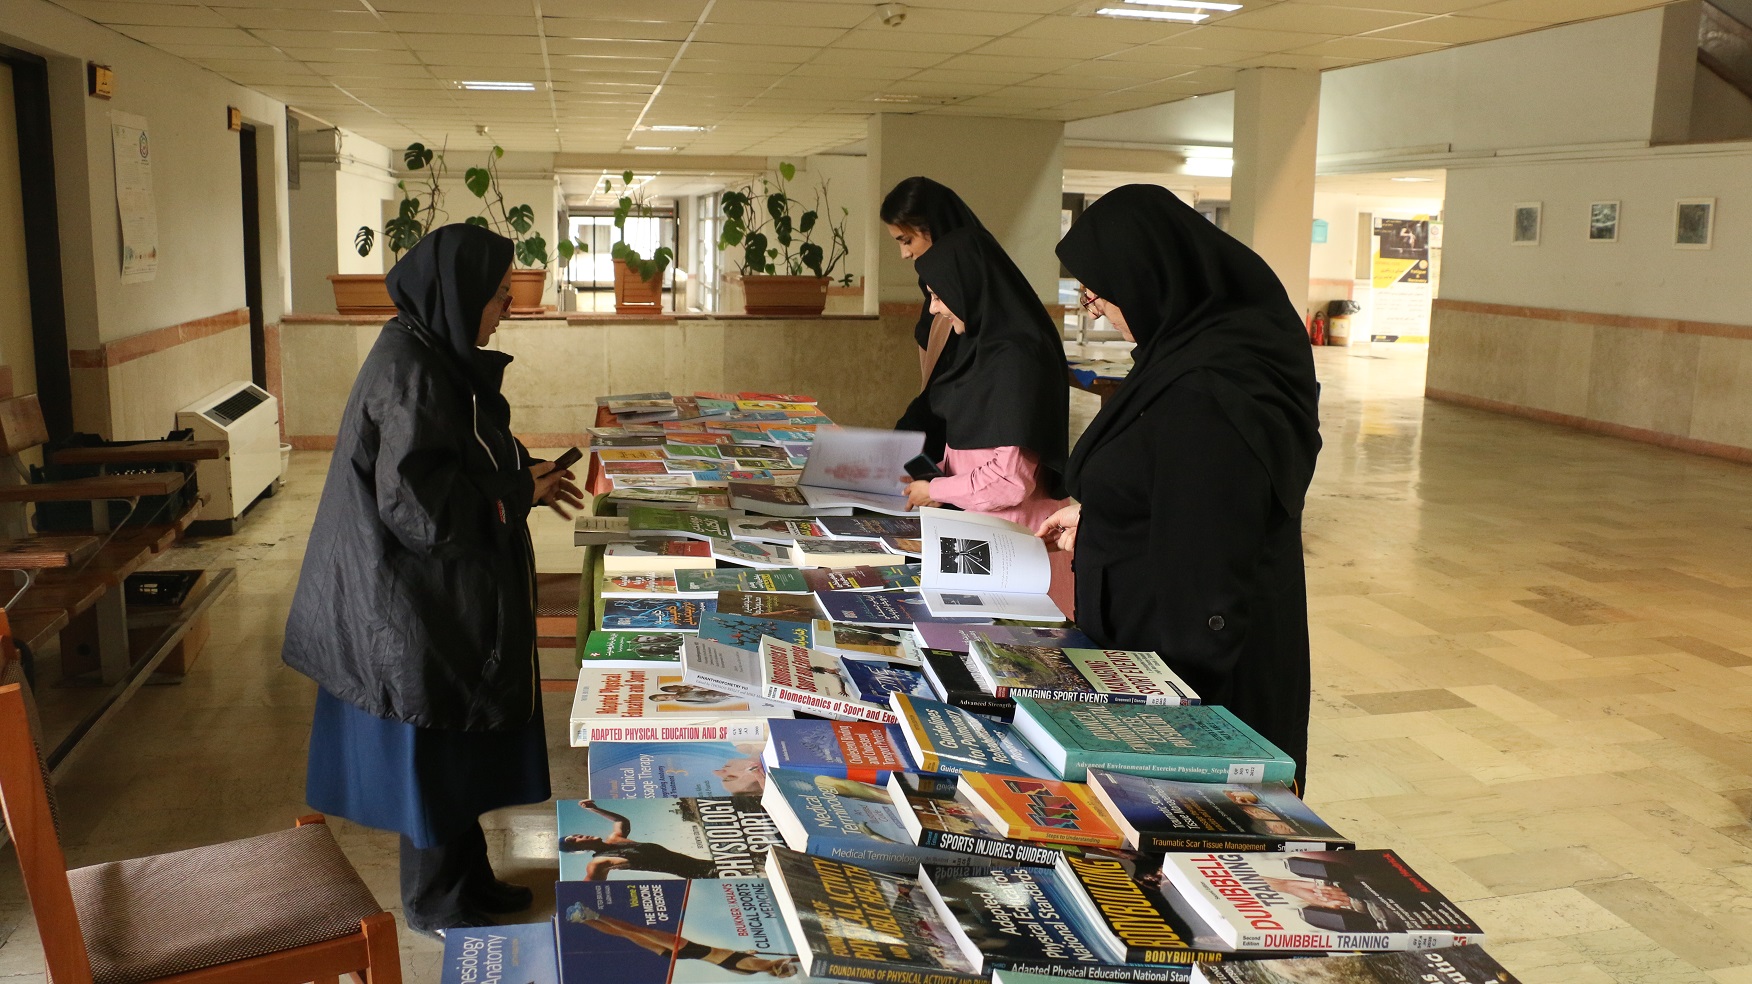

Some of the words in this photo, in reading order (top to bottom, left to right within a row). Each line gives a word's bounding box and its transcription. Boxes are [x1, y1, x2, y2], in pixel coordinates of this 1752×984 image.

[767, 643, 787, 653] of
[791, 646, 811, 667] Exercise
[769, 651, 792, 687] Biomechanics
[793, 665, 814, 677] and
[1103, 650, 1144, 674] EVENTS
[599, 673, 624, 693] Physical
[625, 670, 648, 683] Sport
[794, 674, 818, 693] Sport
[1084, 660, 1135, 693] MANAGING
[1123, 674, 1164, 695] SPORT
[624, 684, 644, 693] and
[1009, 687, 1051, 700] MANAGING
[1052, 690, 1078, 702] SPORT
[1079, 692, 1109, 704] EVENTS
[595, 694, 622, 714] Adapted
[621, 693, 644, 718] Education
[779, 689, 831, 711] Biomechanics
[833, 702, 842, 712] of
[843, 703, 865, 717] Sport
[866, 709, 880, 720] and
[960, 699, 987, 707] Advanced
[987, 701, 1012, 709] Strength
[591, 728, 623, 741] ADAPTED
[624, 728, 659, 741] PHYSICAL
[661, 727, 700, 740] EDUCATION
[702, 727, 717, 740] AND
[838, 725, 853, 741] Binding
[870, 729, 887, 746] Proteins
[925, 708, 959, 749] Guidelines
[944, 708, 980, 747] Pulmonary
[1070, 710, 1120, 742] ADVANCED
[1085, 705, 1156, 752] ENVIRONMENTAL
[1117, 715, 1168, 743] EXERCISE
[1136, 712, 1197, 749] PHYSIOLOGY
[854, 734, 875, 756] Cholesterol
[966, 715, 1011, 765] Rehabilitation
[842, 741, 862, 764] Cholesterol
[864, 756, 879, 765] and
[877, 745, 896, 766] Transport
[966, 746, 987, 760] for
[638, 753, 655, 780] Therapy
[658, 766, 667, 782] Anatomy
[1076, 760, 1105, 769] Advanced
[1107, 762, 1151, 772] Environmental
[619, 767, 636, 792] Clinical
[642, 781, 658, 799] ssage
[668, 775, 678, 795] Treatment
[817, 784, 861, 835] Terminology
[1147, 793, 1164, 805] Scar
[1148, 784, 1185, 815] Management
[798, 794, 837, 829] Medical
[1156, 805, 1186, 828] Traumatic
[1179, 814, 1201, 829] Tissue
[697, 799, 758, 879] PHYSIOLOGY
[737, 810, 786, 853] SPORT
[1064, 834, 1101, 844] Understanding
[939, 832, 974, 853] SPORTS
[974, 836, 1015, 859] INJURIES
[1015, 845, 1059, 866] GUIDEBOO
[1152, 837, 1185, 848] Traumatic
[1185, 839, 1201, 849] Scar
[1203, 840, 1224, 849] Tissue
[1224, 841, 1266, 852] Management
[831, 848, 866, 860] Medical
[867, 851, 921, 865] Terminology
[810, 857, 859, 907] ACTIVITY
[841, 864, 886, 906] HEALTH
[1217, 854, 1290, 907] TRAINING
[629, 889, 639, 908] Volume
[639, 884, 654, 913] MEDICINE
[651, 884, 667, 911] EXERCISE
[722, 883, 738, 904] KHAN'S
[735, 883, 757, 911] SPORTS
[751, 883, 777, 919] MEDICINE
[990, 870, 1035, 920] Education
[1010, 869, 1060, 920] Standards
[1068, 856, 1189, 949] BODYBUILDING
[1189, 854, 1285, 931] DUMBBELL
[811, 899, 831, 910] OF
[971, 891, 1022, 936] Adapted
[644, 912, 657, 926] THE
[657, 912, 669, 922] OF
[729, 908, 749, 937] BRUKNER
[862, 903, 905, 938] UBLIC
[745, 912, 770, 949] CLINICAL
[834, 906, 887, 961] PHYCAL
[1018, 921, 1069, 959] Physical
[1043, 921, 1098, 962] National
[1263, 934, 1333, 949] DUMBBELL
[1337, 935, 1390, 949] TRAINING
[456, 936, 484, 984] nesiology
[481, 934, 508, 984] Anatomy
[889, 946, 910, 959] AND
[1144, 950, 1222, 963] BODYBUILDING
[829, 964, 876, 980] FOUNDATIONS
[876, 969, 886, 980] OF
[886, 971, 922, 984] PHYSICAL
[924, 974, 958, 984] ACTIVITY
[1011, 963, 1051, 976] Adapted
[1052, 965, 1086, 978] Physical
[1088, 966, 1131, 980] Education
[1132, 969, 1168, 981] National
[1209, 965, 1228, 980] LONG
